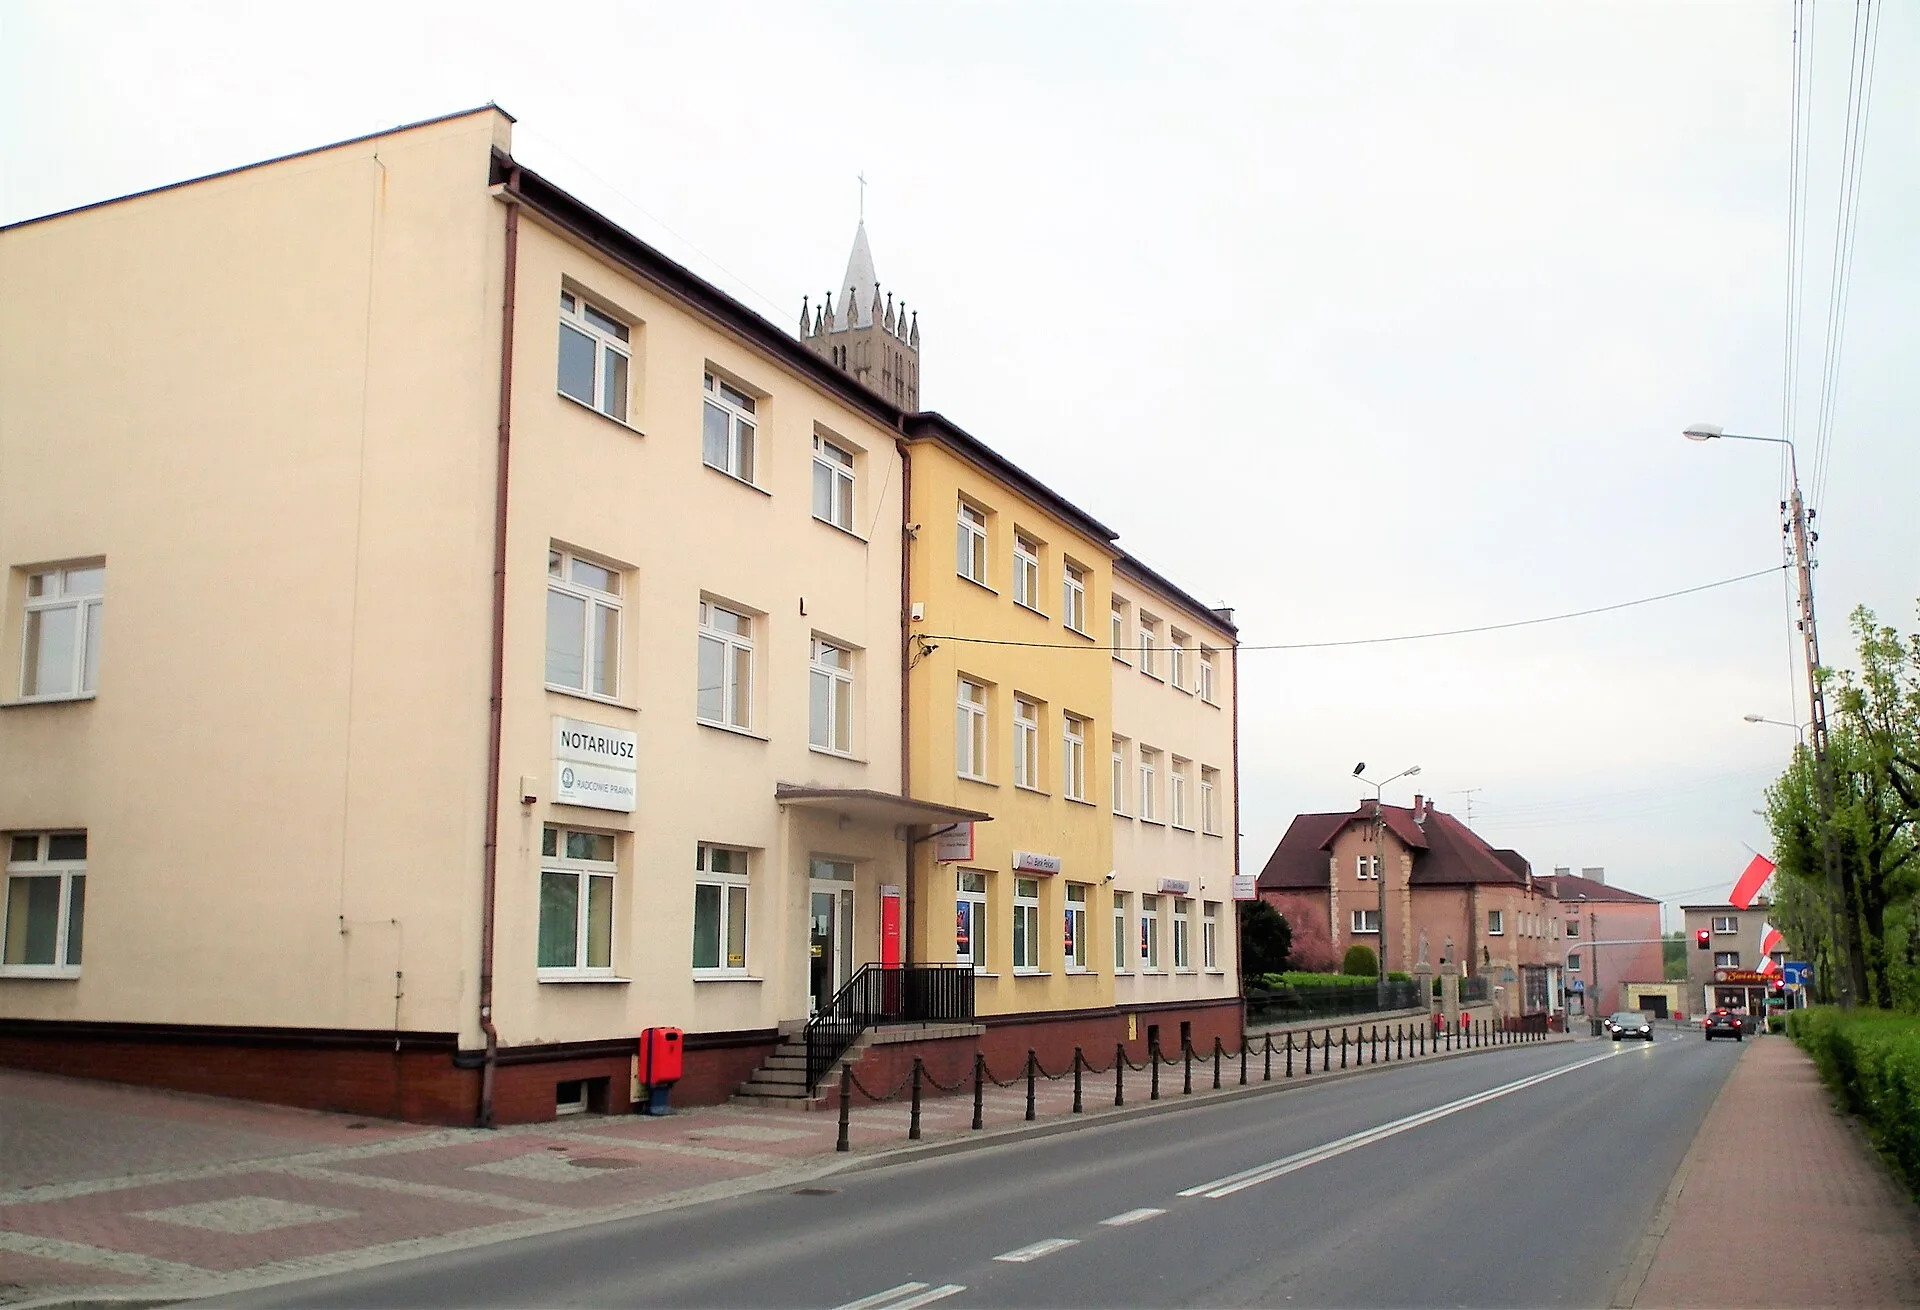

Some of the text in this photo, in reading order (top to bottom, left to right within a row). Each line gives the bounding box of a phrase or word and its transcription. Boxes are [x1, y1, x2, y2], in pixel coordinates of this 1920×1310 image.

[561, 730, 634, 758] NOTARIUSZ
[576, 779, 634, 796] RADCOWIE PRAWNI
